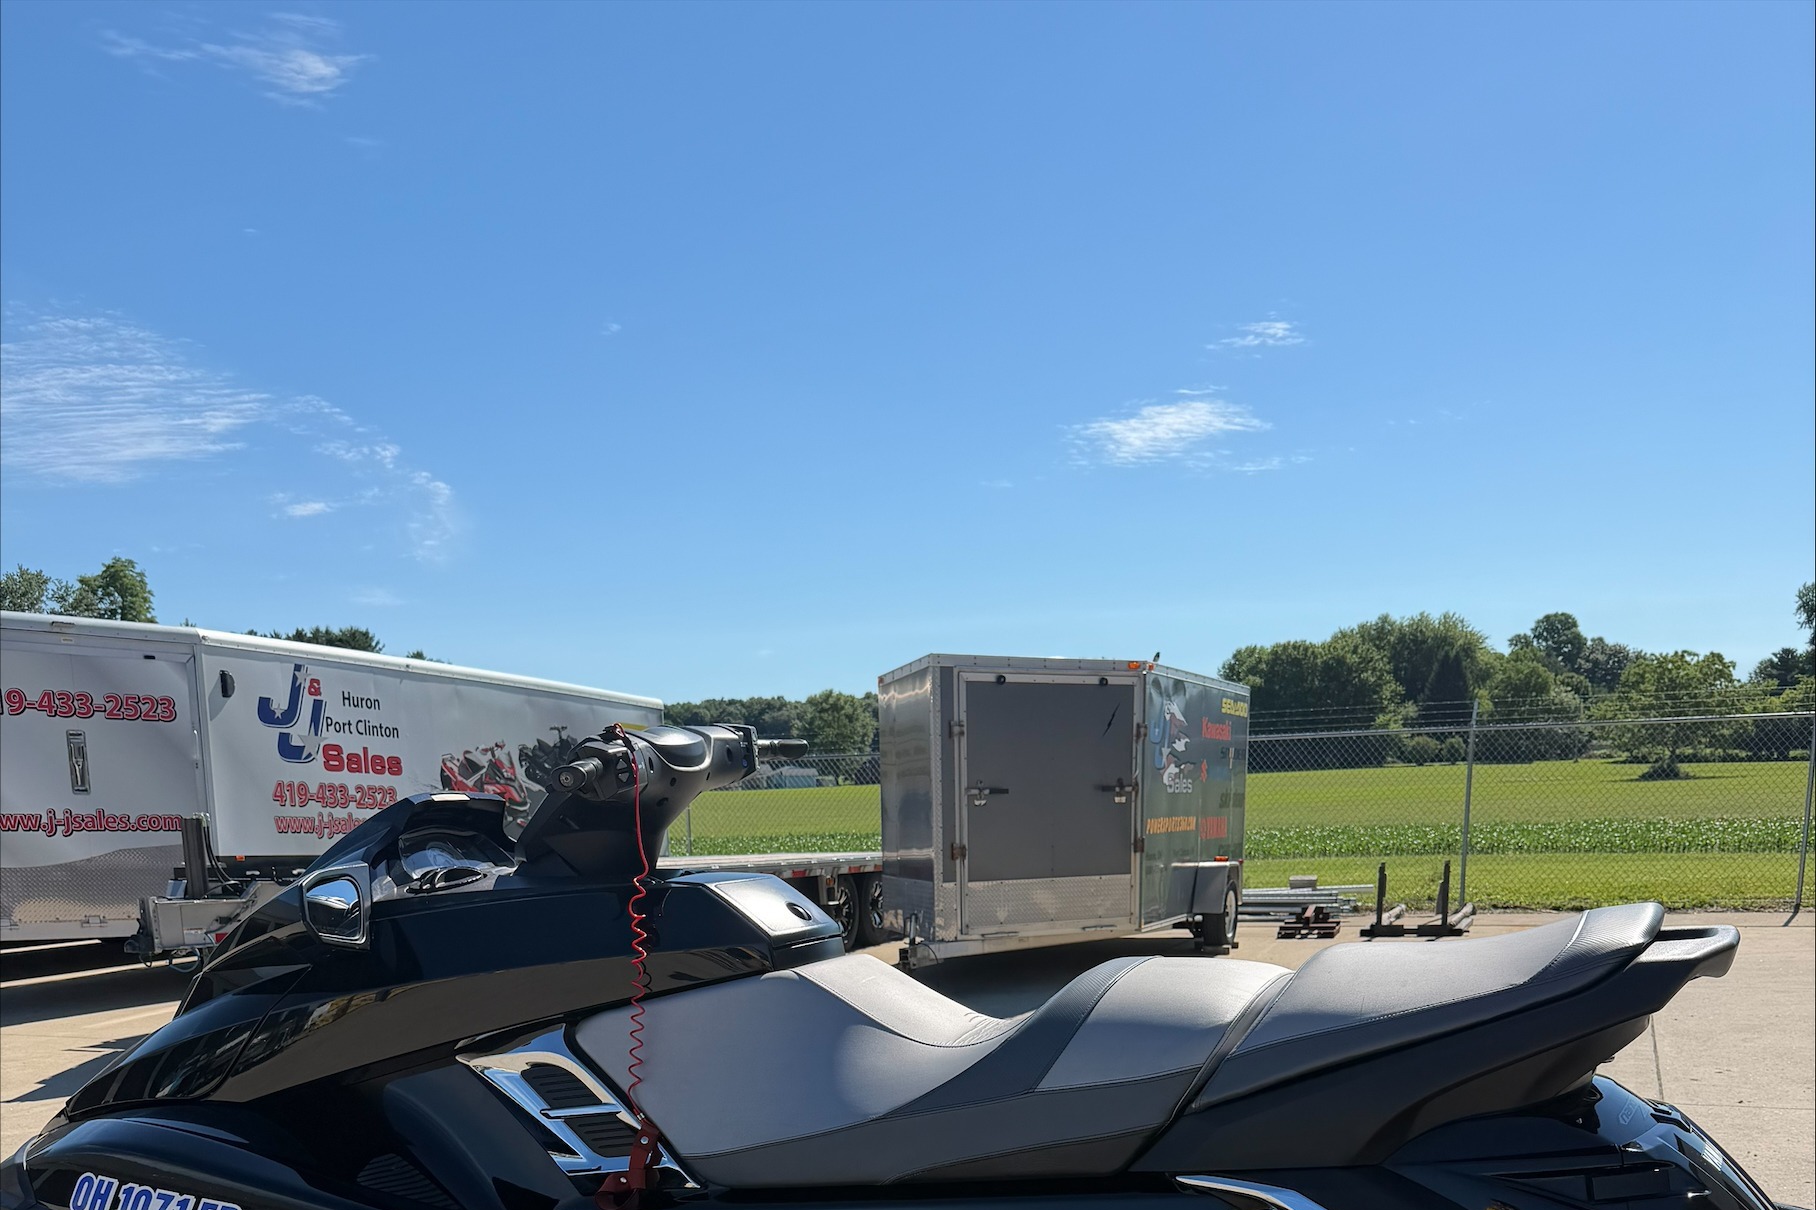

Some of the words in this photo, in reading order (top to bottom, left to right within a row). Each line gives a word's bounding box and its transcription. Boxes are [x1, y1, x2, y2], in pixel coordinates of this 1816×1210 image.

[0, 688, 177, 722] 9-433-2523
[342, 690, 381, 711] Huron
[325, 716, 353, 735] Port
[355, 719, 400, 739] Clinton
[322, 743, 403, 776] Sales
[272, 780, 398, 810] 419-433-2523
[1166, 773, 1193, 793] Sales
